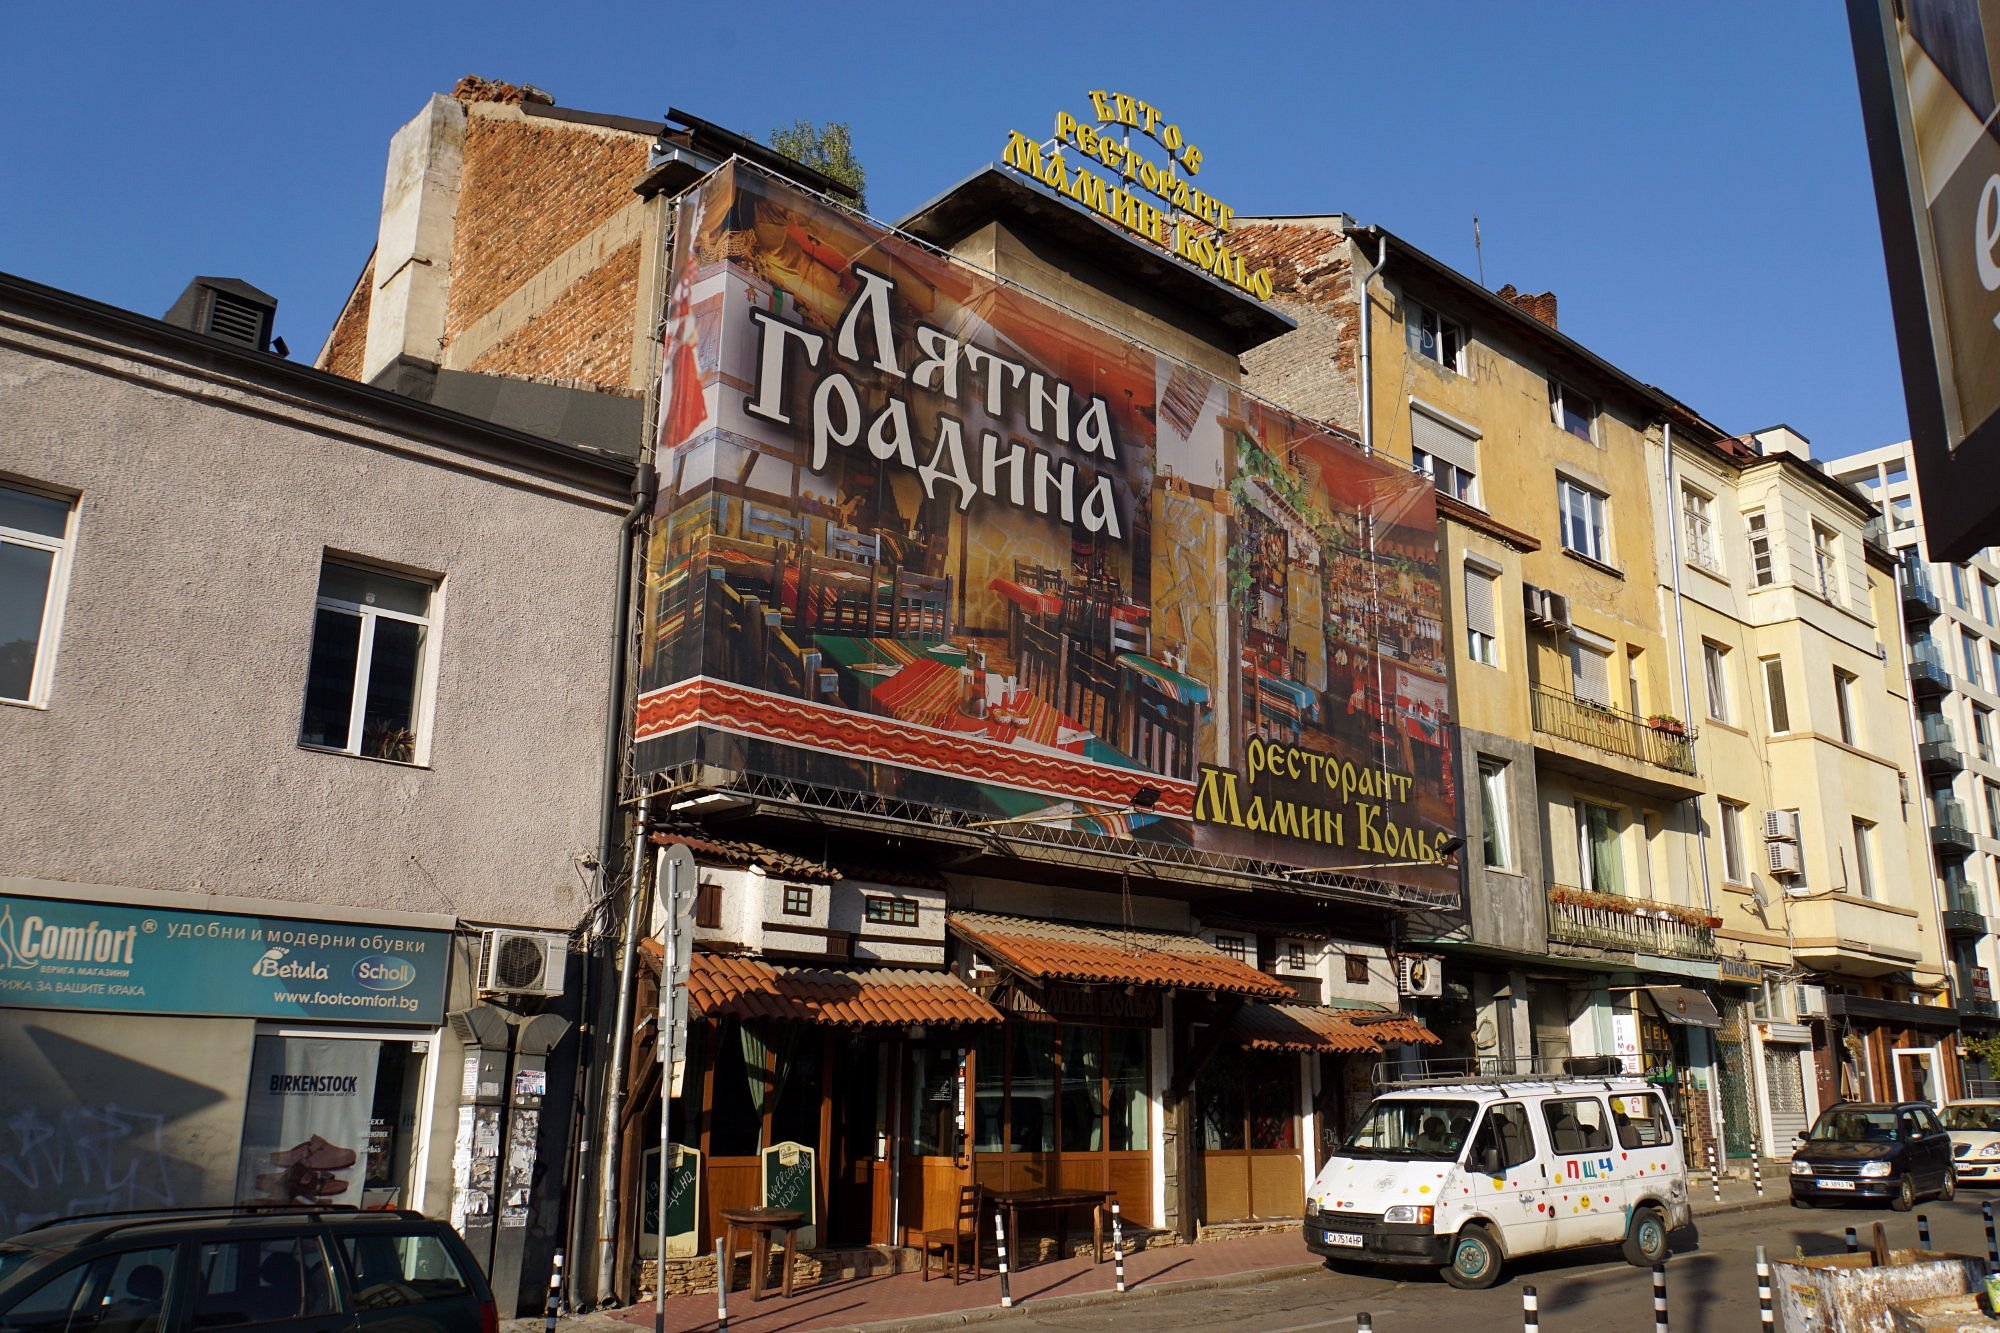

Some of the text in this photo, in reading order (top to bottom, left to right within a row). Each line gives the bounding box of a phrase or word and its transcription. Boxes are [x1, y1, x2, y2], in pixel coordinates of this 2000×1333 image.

[1054, 111, 1235, 233] РЕСТОРАНТ
[1003, 129, 1273, 301] МАМИН КОЛЬО
[837, 267, 1116, 460] Лятна
[748, 312, 1122, 539] Градина
[1195, 767, 1344, 847] Мамин
[19, 915, 138, 965] Comfort
[167, 921, 425, 954] удобни и модерни обувки
[40, 965, 130, 978] ВЕРИГА МАГАЗИНИ
[260, 957, 329, 980] Betula
[358, 962, 409, 982] Scholl
[35, 980, 51, 992] ЗА
[55, 982, 105, 994] ВАШИТЕ
[107, 984, 146, 996] КРАКА
[273, 991, 419, 1011] www.footcomfort.bg
[270, 1074, 358, 1093] BIRKENSTOCK
